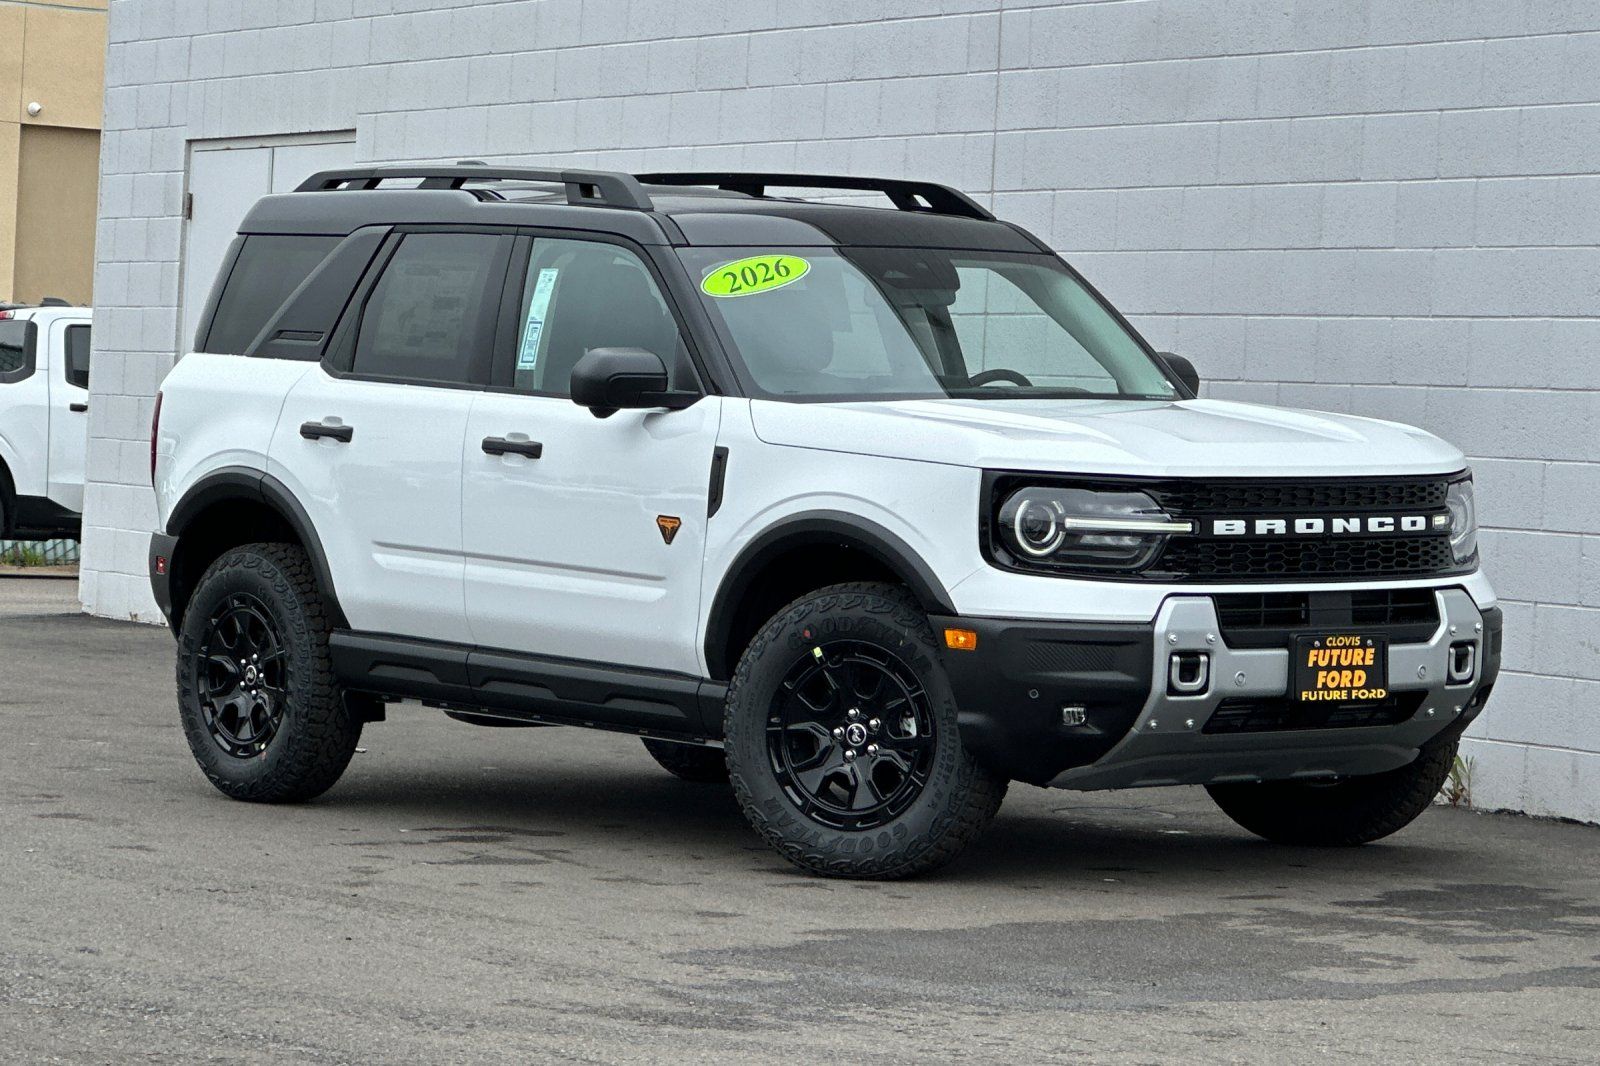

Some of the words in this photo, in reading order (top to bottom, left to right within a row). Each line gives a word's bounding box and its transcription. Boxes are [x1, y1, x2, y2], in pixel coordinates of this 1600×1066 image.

[723, 258, 790, 293] 2026
[1213, 516, 1426, 535] BRONCO
[1326, 636, 1361, 647] CLOVIS
[1307, 648, 1376, 667] FUTURE
[1316, 669, 1367, 689] FORD
[1301, 690, 1348, 701] FUTURE
[1351, 688, 1387, 700] FORD
